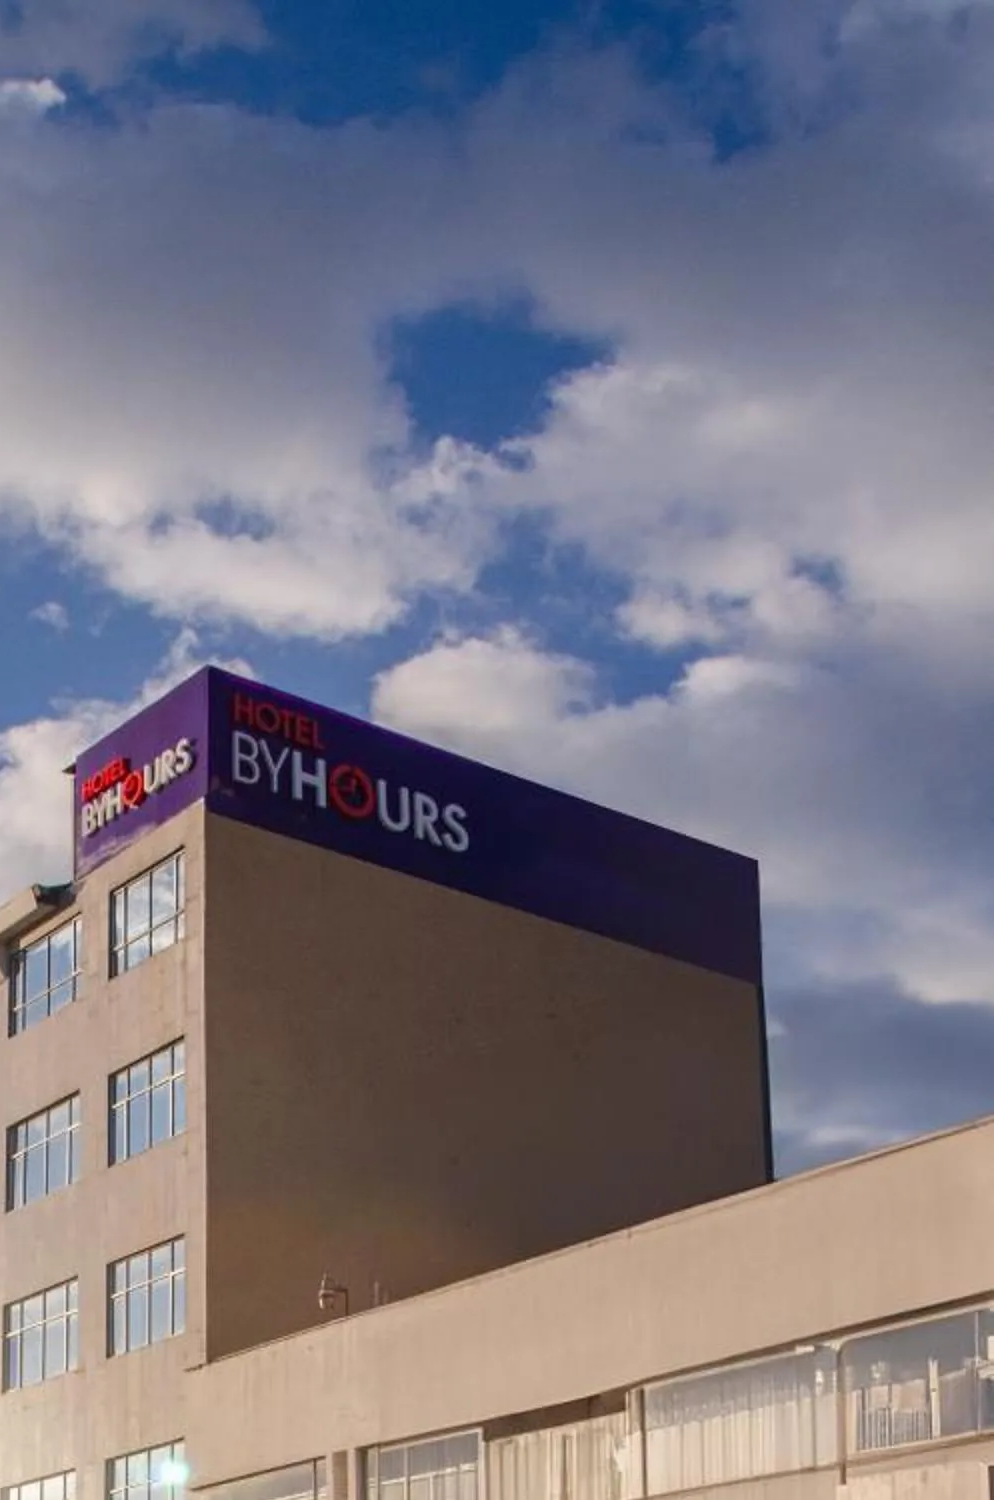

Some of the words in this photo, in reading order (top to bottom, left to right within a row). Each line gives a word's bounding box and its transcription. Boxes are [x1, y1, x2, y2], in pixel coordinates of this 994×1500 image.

[233, 692, 325, 749] HOTEL
[81, 754, 126, 803] HOTEL
[81, 737, 193, 837] BYHOURS
[232, 730, 470, 853] BYHOURS
